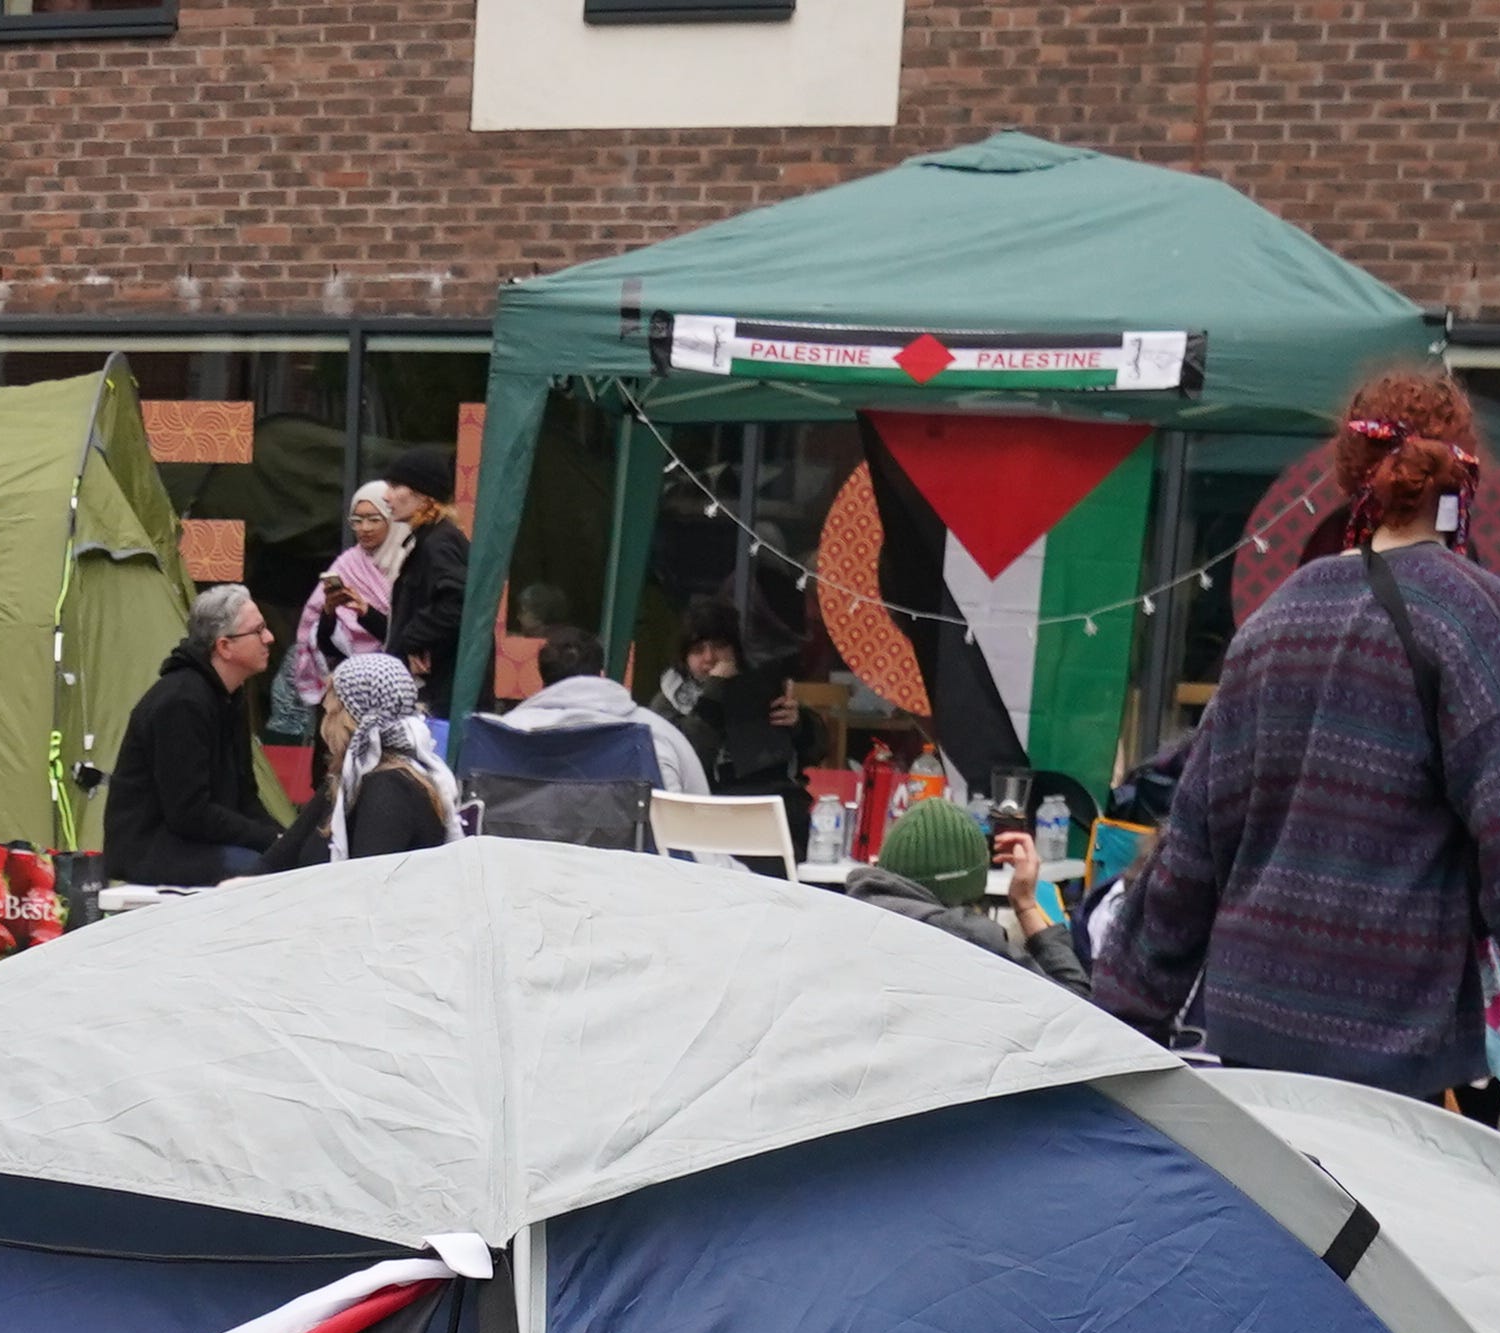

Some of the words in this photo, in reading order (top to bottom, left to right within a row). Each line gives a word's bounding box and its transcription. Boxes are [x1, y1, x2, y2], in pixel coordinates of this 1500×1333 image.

[750, 342, 871, 365] PALESTINE
[976, 350, 1100, 368] PALESTINE
[5, 895, 56, 920] Best
